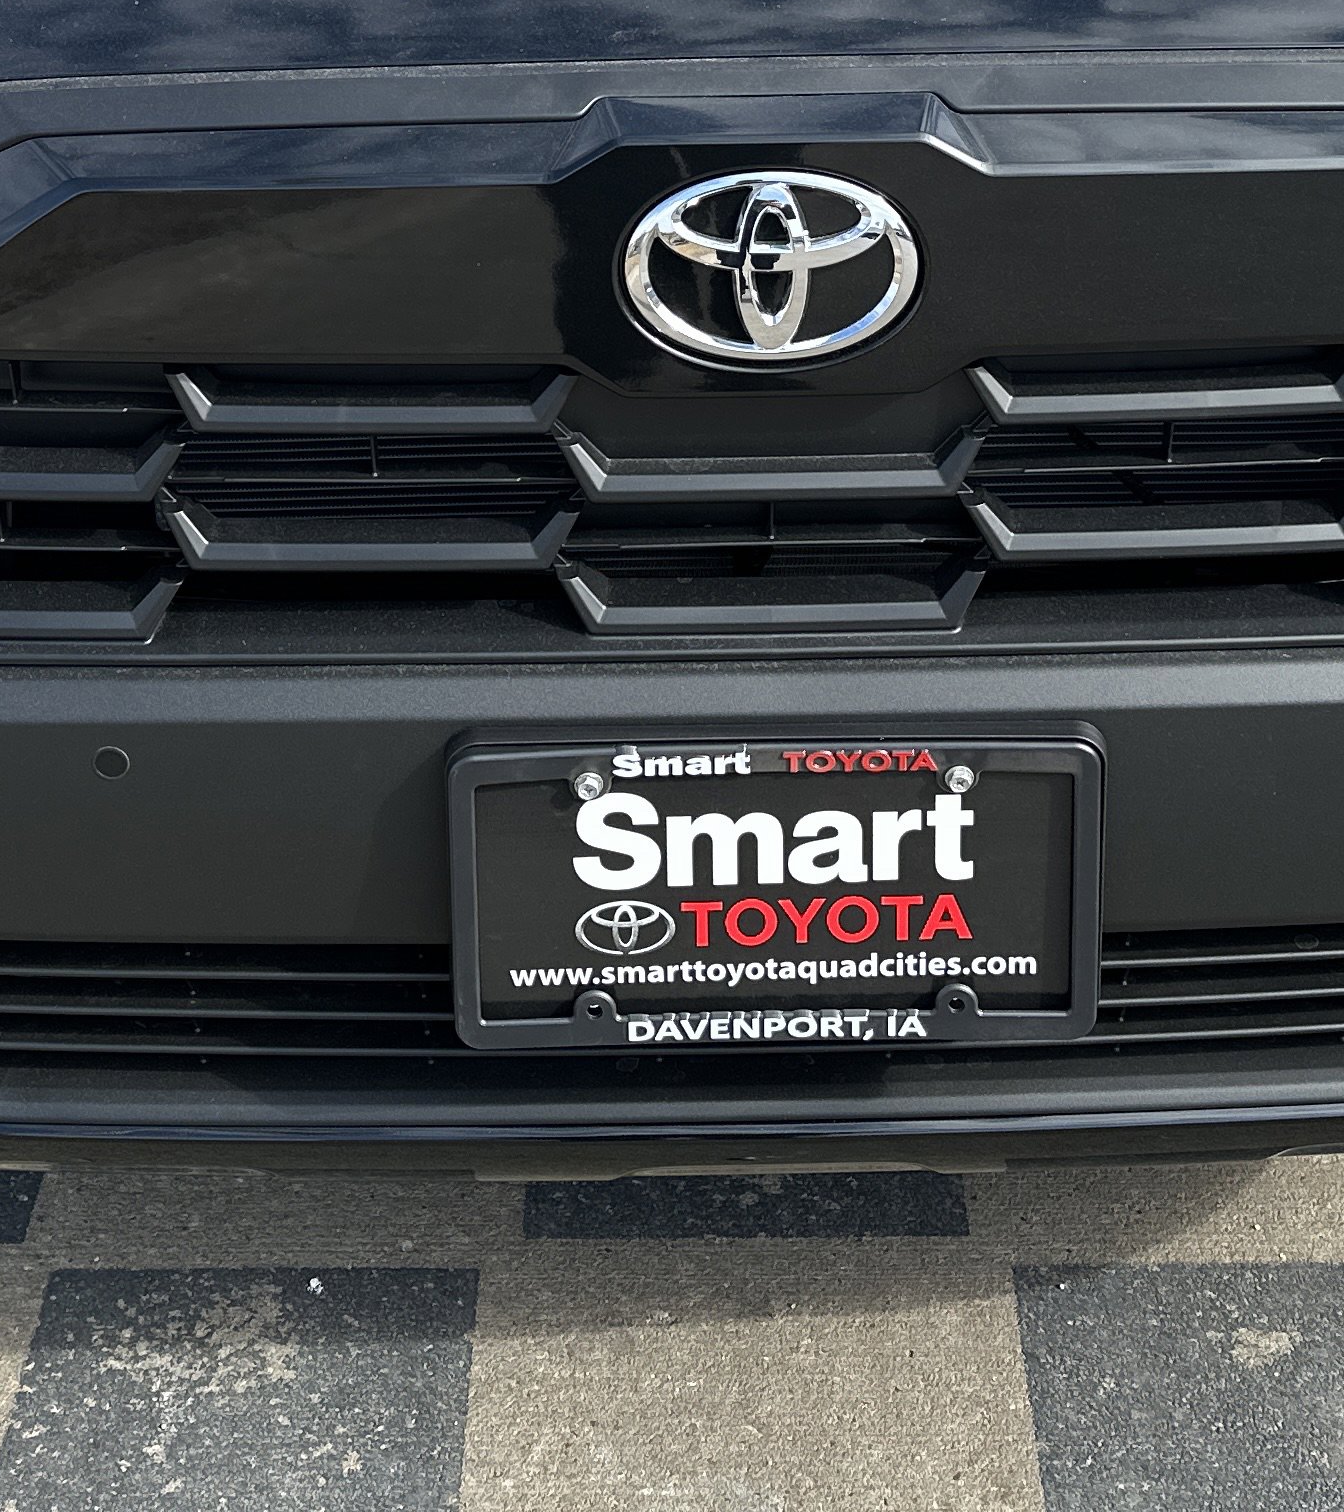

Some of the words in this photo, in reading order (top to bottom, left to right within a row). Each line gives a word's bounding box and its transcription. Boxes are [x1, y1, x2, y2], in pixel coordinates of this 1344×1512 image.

[612, 745, 752, 778] Smart
[782, 749, 939, 773] TOYOTA
[571, 791, 975, 891] Smart
[679, 893, 974, 948] TOYOTA
[509, 951, 1038, 988] www.smarttoyotaquadcities.com
[626, 1014, 874, 1043] DAVENPORT,
[886, 1013, 928, 1038] IA
